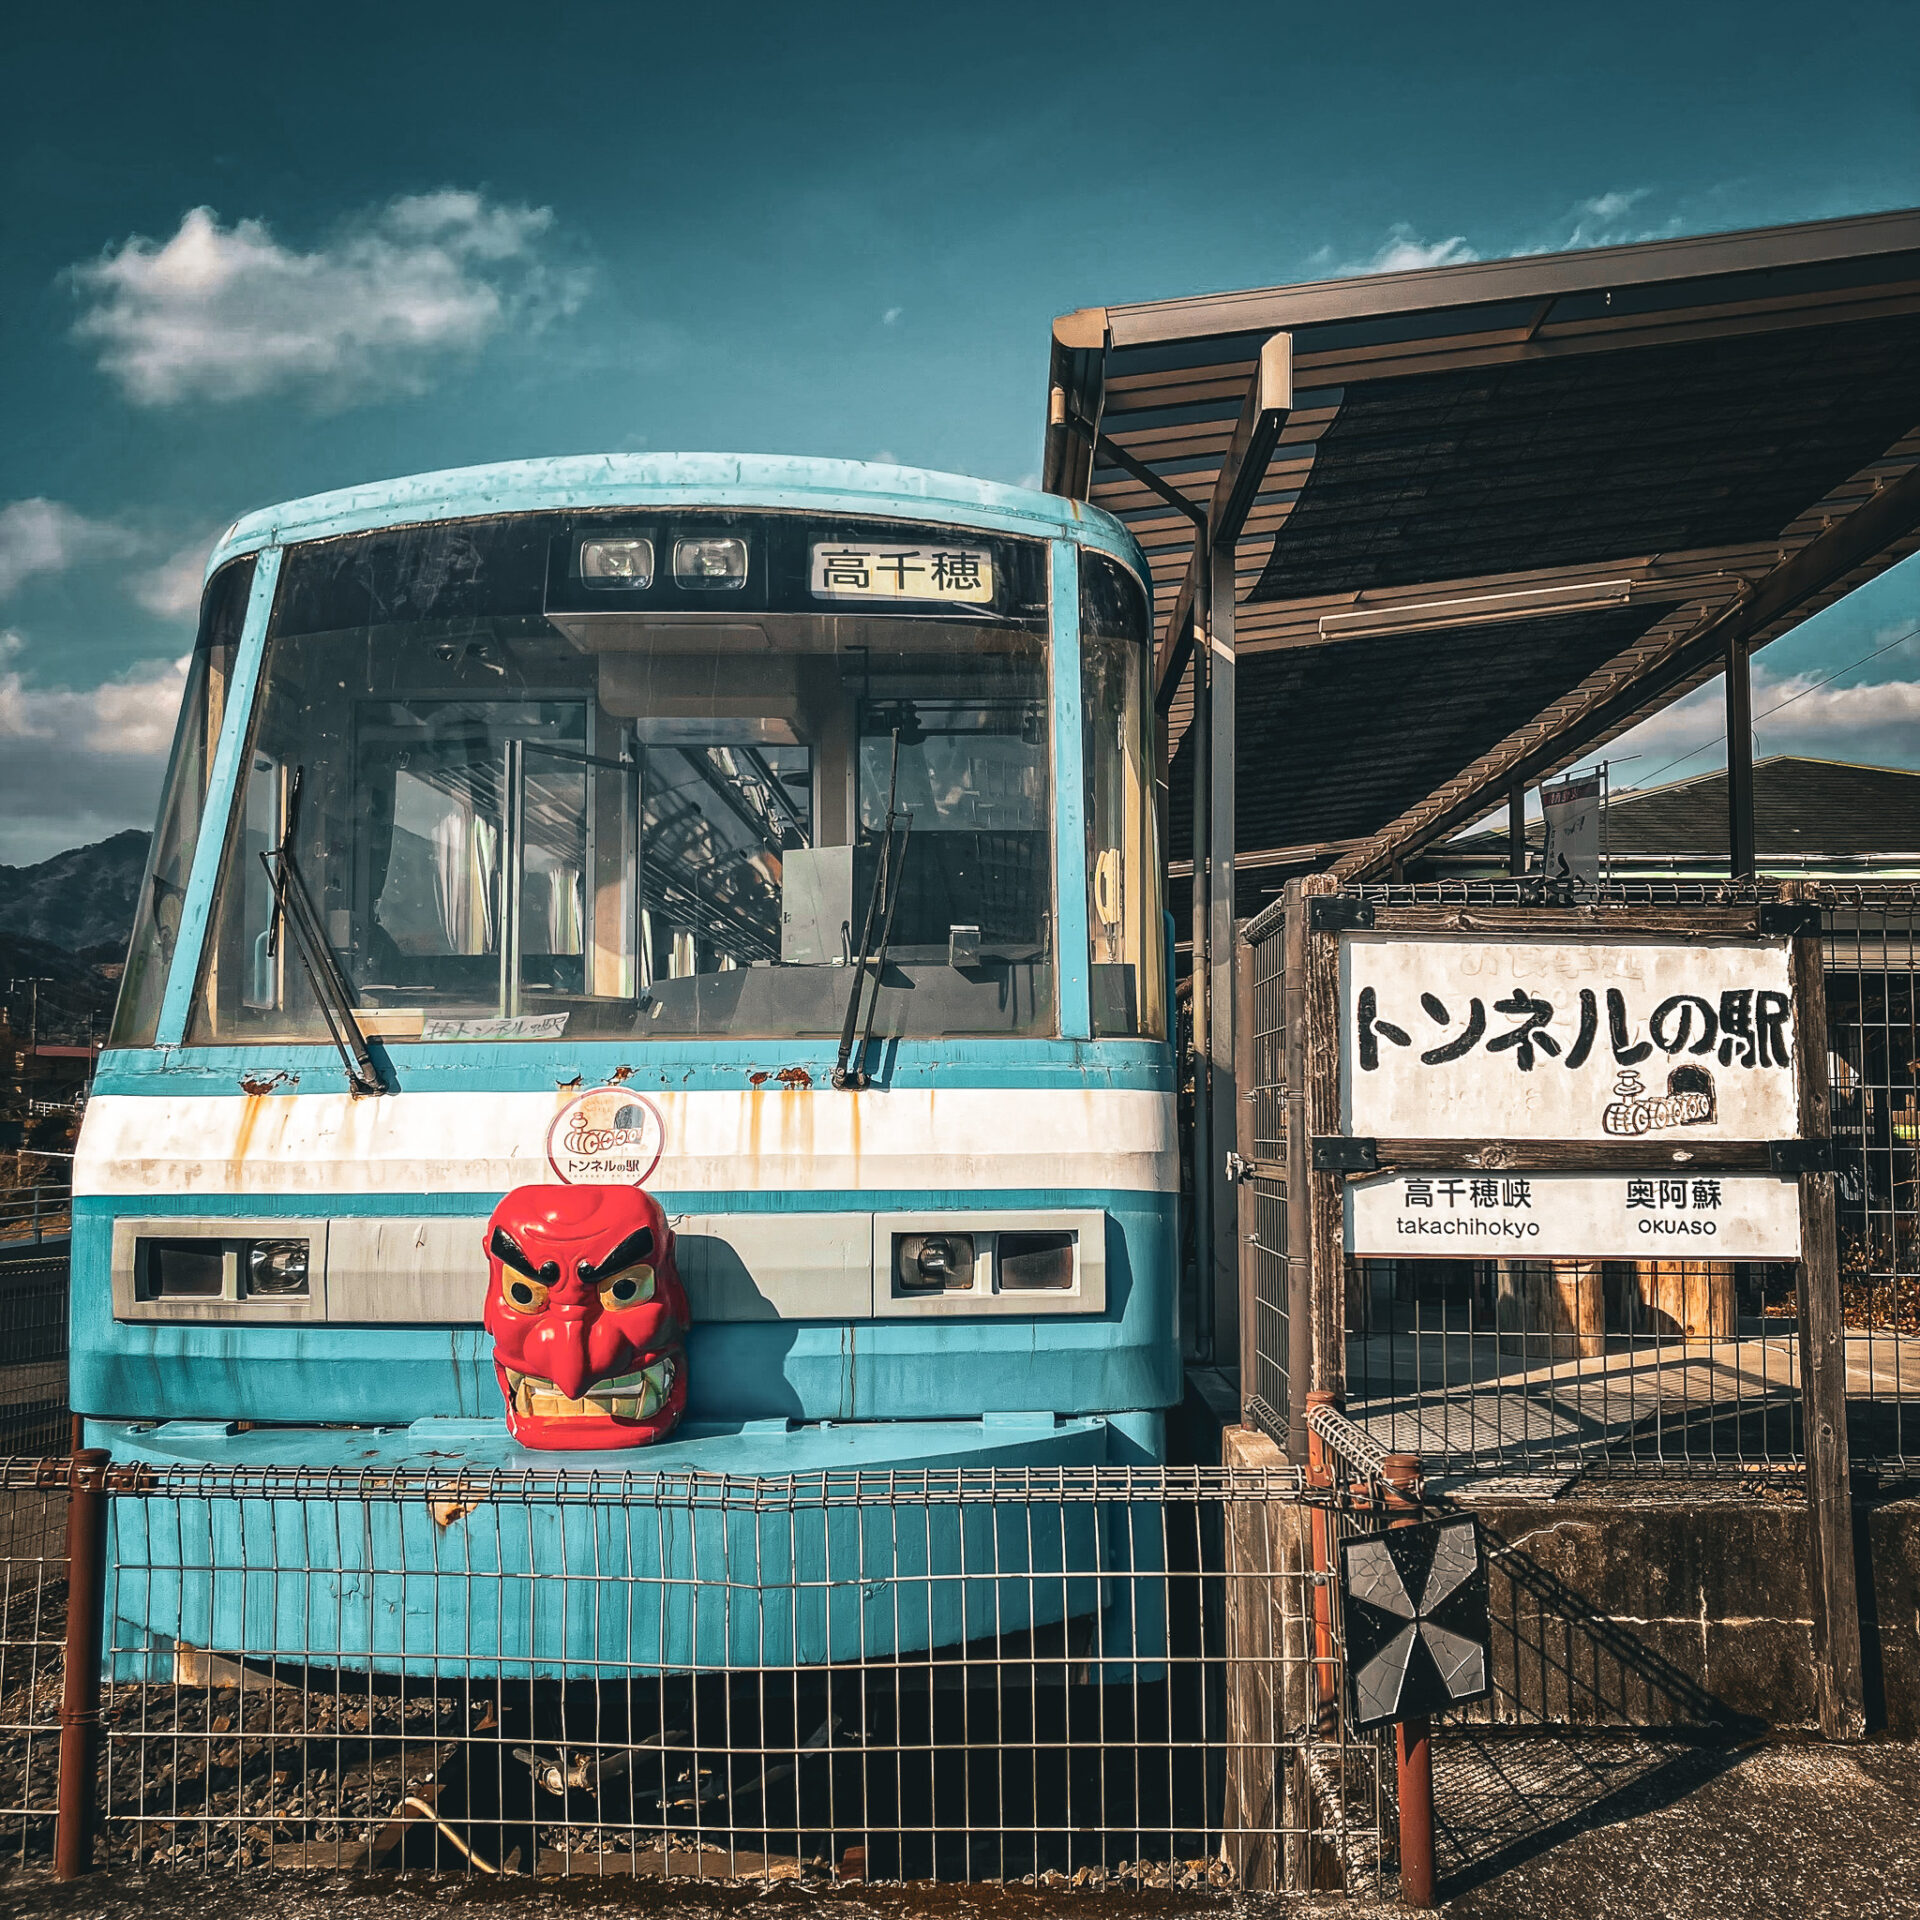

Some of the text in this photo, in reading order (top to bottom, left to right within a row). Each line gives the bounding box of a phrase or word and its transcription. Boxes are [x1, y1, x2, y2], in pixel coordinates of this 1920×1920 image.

[821, 549, 982, 591] 高千穂
[1357, 985, 1791, 1072] トンネルの駅
[568, 1159, 640, 1173] トンネルの駅
[1404, 1179, 1532, 1209] 高千穂峡
[1625, 1178, 1723, 1210] 奥阿蘇
[1396, 1217, 1541, 1239] takachihokyo
[1638, 1218, 1717, 1236] OKUASO
